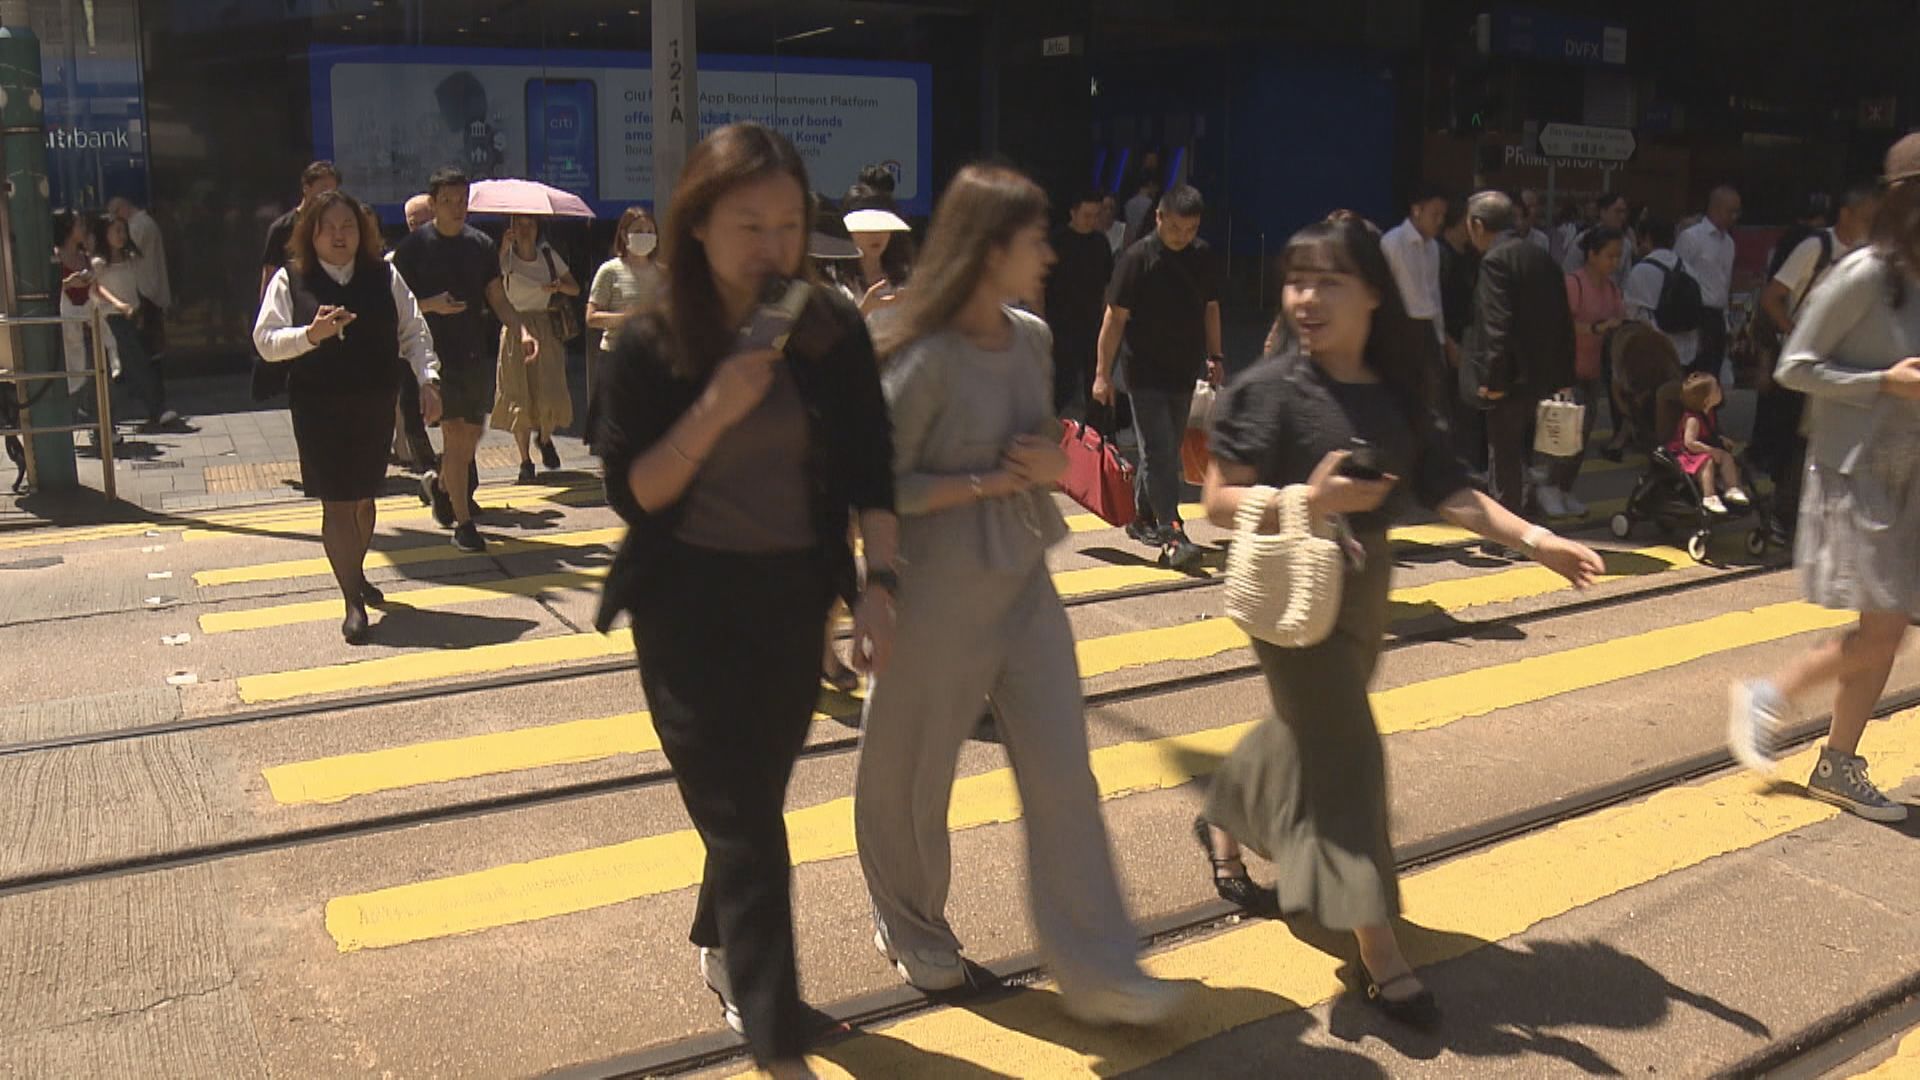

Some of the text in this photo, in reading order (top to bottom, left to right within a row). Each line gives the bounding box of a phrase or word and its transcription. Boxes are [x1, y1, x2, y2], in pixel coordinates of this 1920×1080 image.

[1565, 39, 1600, 58] DVFX
[700, 91, 724, 105] App
[727, 93, 759, 105] Bond
[762, 94, 827, 106] Investment
[831, 96, 879, 108] Platform
[792, 113, 805, 127] of
[807, 114, 843, 128] bonds
[46, 126, 129, 149] itibank
[624, 131, 653, 141] amo
